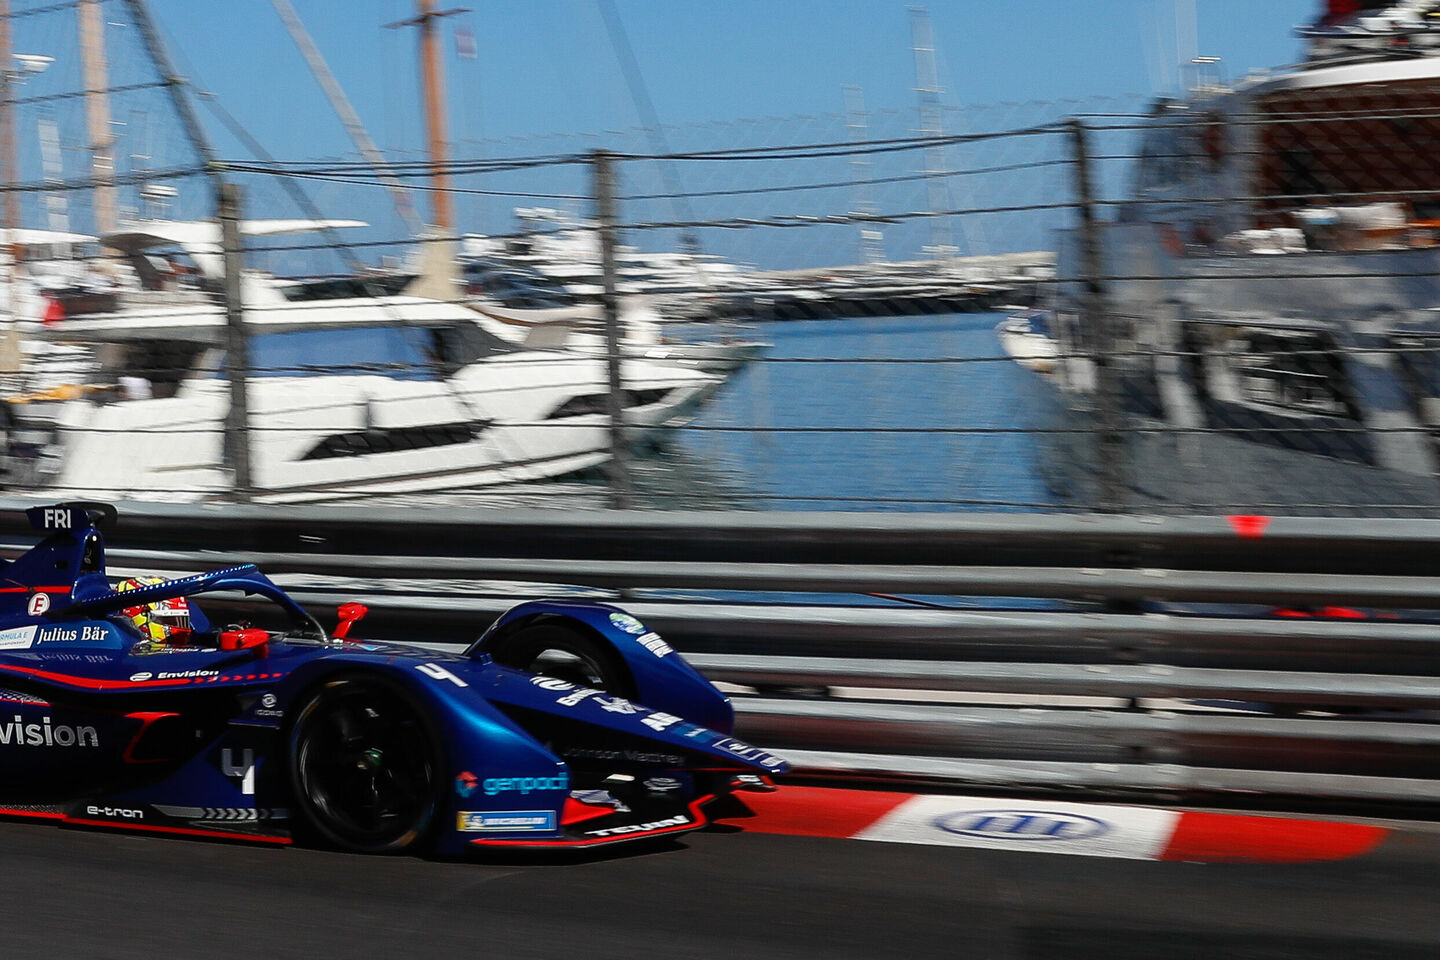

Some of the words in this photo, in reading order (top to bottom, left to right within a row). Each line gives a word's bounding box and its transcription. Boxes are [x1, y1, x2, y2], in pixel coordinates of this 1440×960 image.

[44, 508, 72, 529] FRI
[33, 597, 44, 613] E
[37, 627, 77, 645] Julius
[81, 626, 109, 641] Bär
[157, 670, 219, 679] Envision
[415, 662, 469, 687] 4
[222, 748, 255, 794] 4
[87, 806, 144, 819] e-tron
